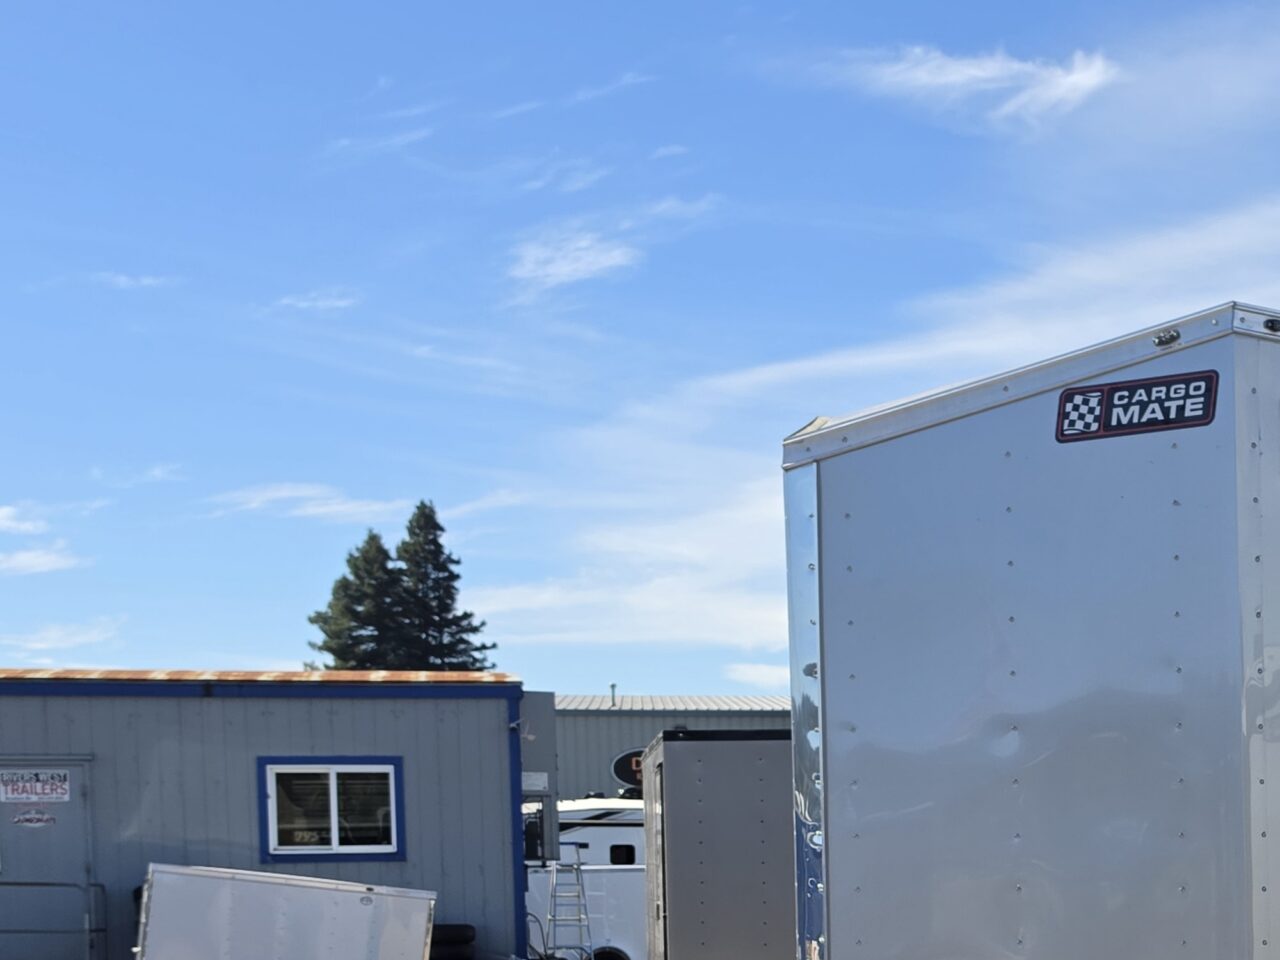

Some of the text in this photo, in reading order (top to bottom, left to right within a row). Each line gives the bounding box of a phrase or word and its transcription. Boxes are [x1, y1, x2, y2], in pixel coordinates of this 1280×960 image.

[1112, 380, 1207, 406] CARGO
[1110, 397, 1205, 427] MATE
[3, 781, 68, 796] TRAILERS
